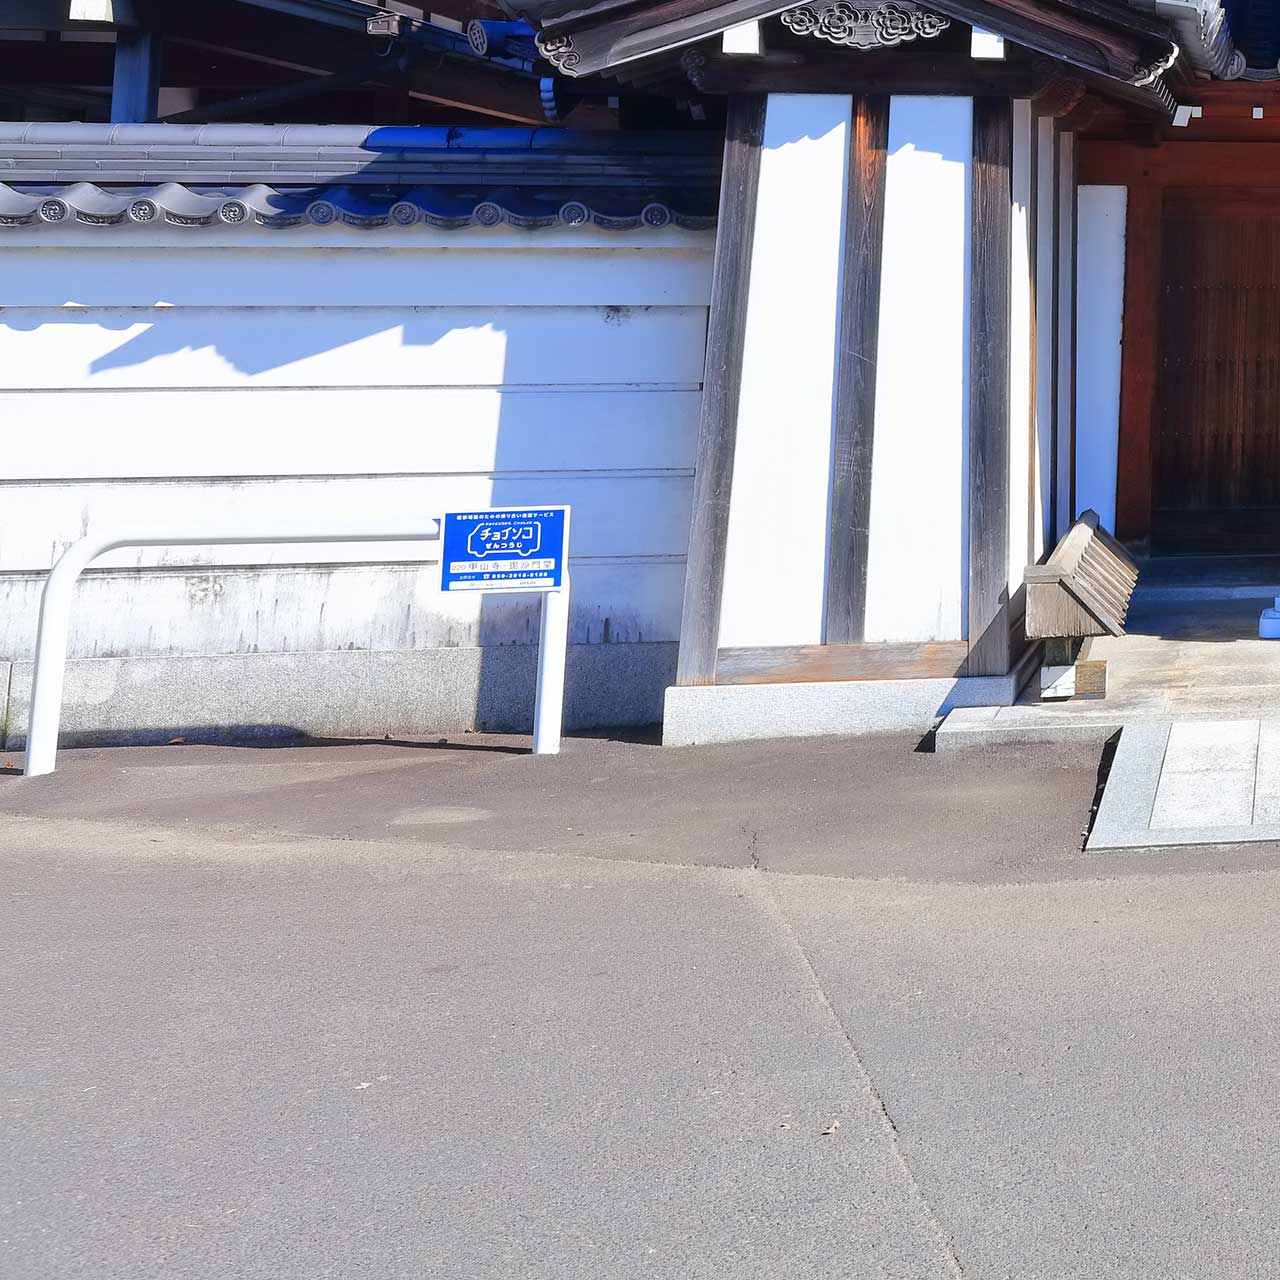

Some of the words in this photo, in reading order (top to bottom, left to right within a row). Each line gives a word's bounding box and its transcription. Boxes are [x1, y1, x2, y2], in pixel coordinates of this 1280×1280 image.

[480, 527, 533, 541] チョイソコ
